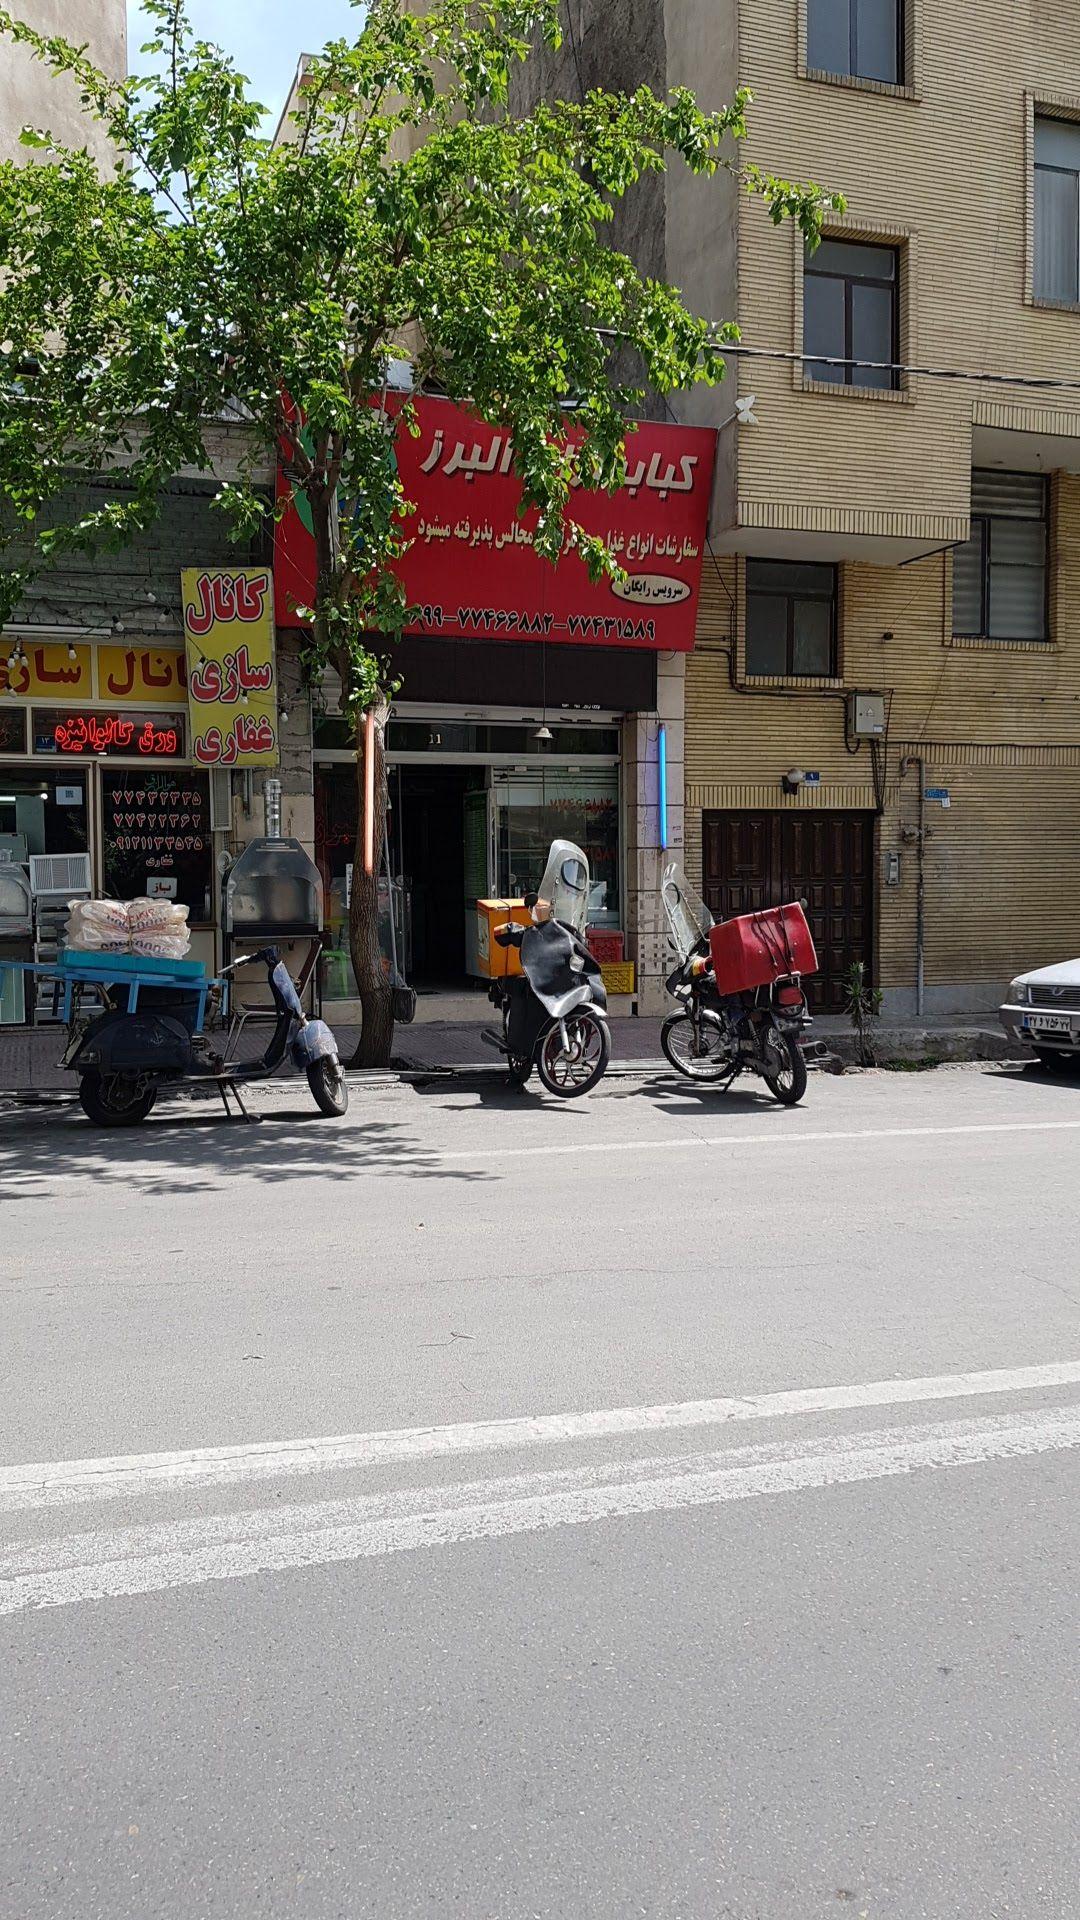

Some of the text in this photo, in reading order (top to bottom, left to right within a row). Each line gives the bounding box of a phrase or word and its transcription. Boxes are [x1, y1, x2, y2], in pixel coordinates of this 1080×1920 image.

[418, 515, 451, 543] میشود
[495, 520, 533, 549] مجالس
[626, 531, 654, 560] انواع
[655, 534, 698, 563] سفارشات
[187, 573, 269, 634] کانال
[623, 580, 683, 598] سرویس رایگان
[107, 651, 187, 695] انال
[191, 645, 272, 703] سازی
[139, 721, 177, 752] ورق
[195, 714, 275, 764] غفاری
[110, 836, 202, 850] ۰۹۱۲۱۱۳۳۵۴۵
[152, 882, 171, 893] باز
